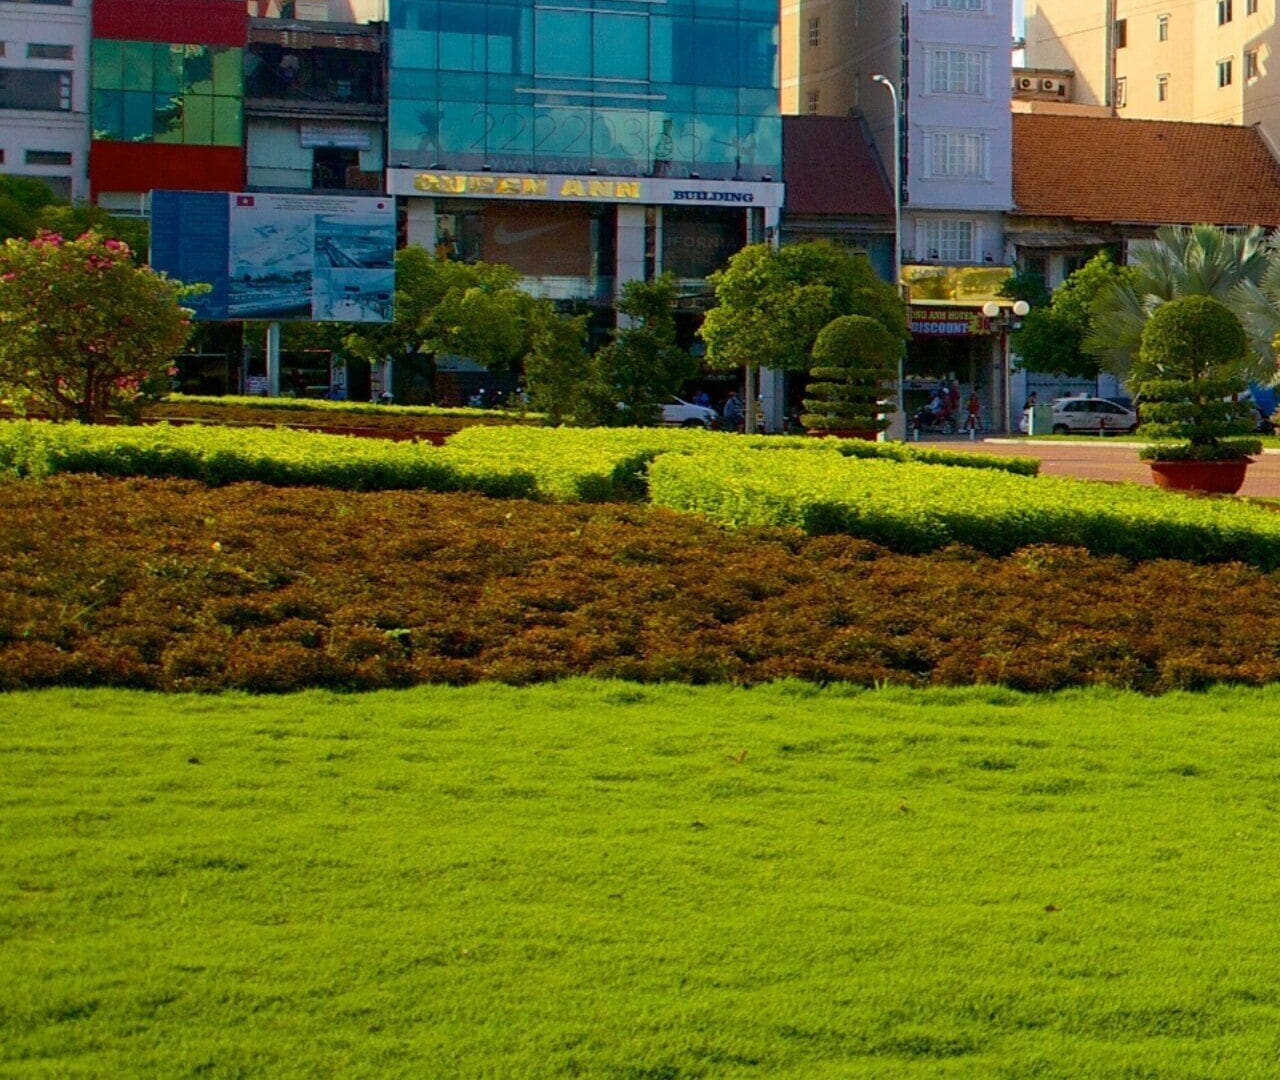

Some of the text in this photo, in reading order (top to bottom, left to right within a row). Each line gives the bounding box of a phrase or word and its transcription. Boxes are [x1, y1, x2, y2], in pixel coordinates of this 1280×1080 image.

[412, 173, 755, 204] QUEEN ANN BUILDING
[910, 321, 969, 334] DISCOUNT
